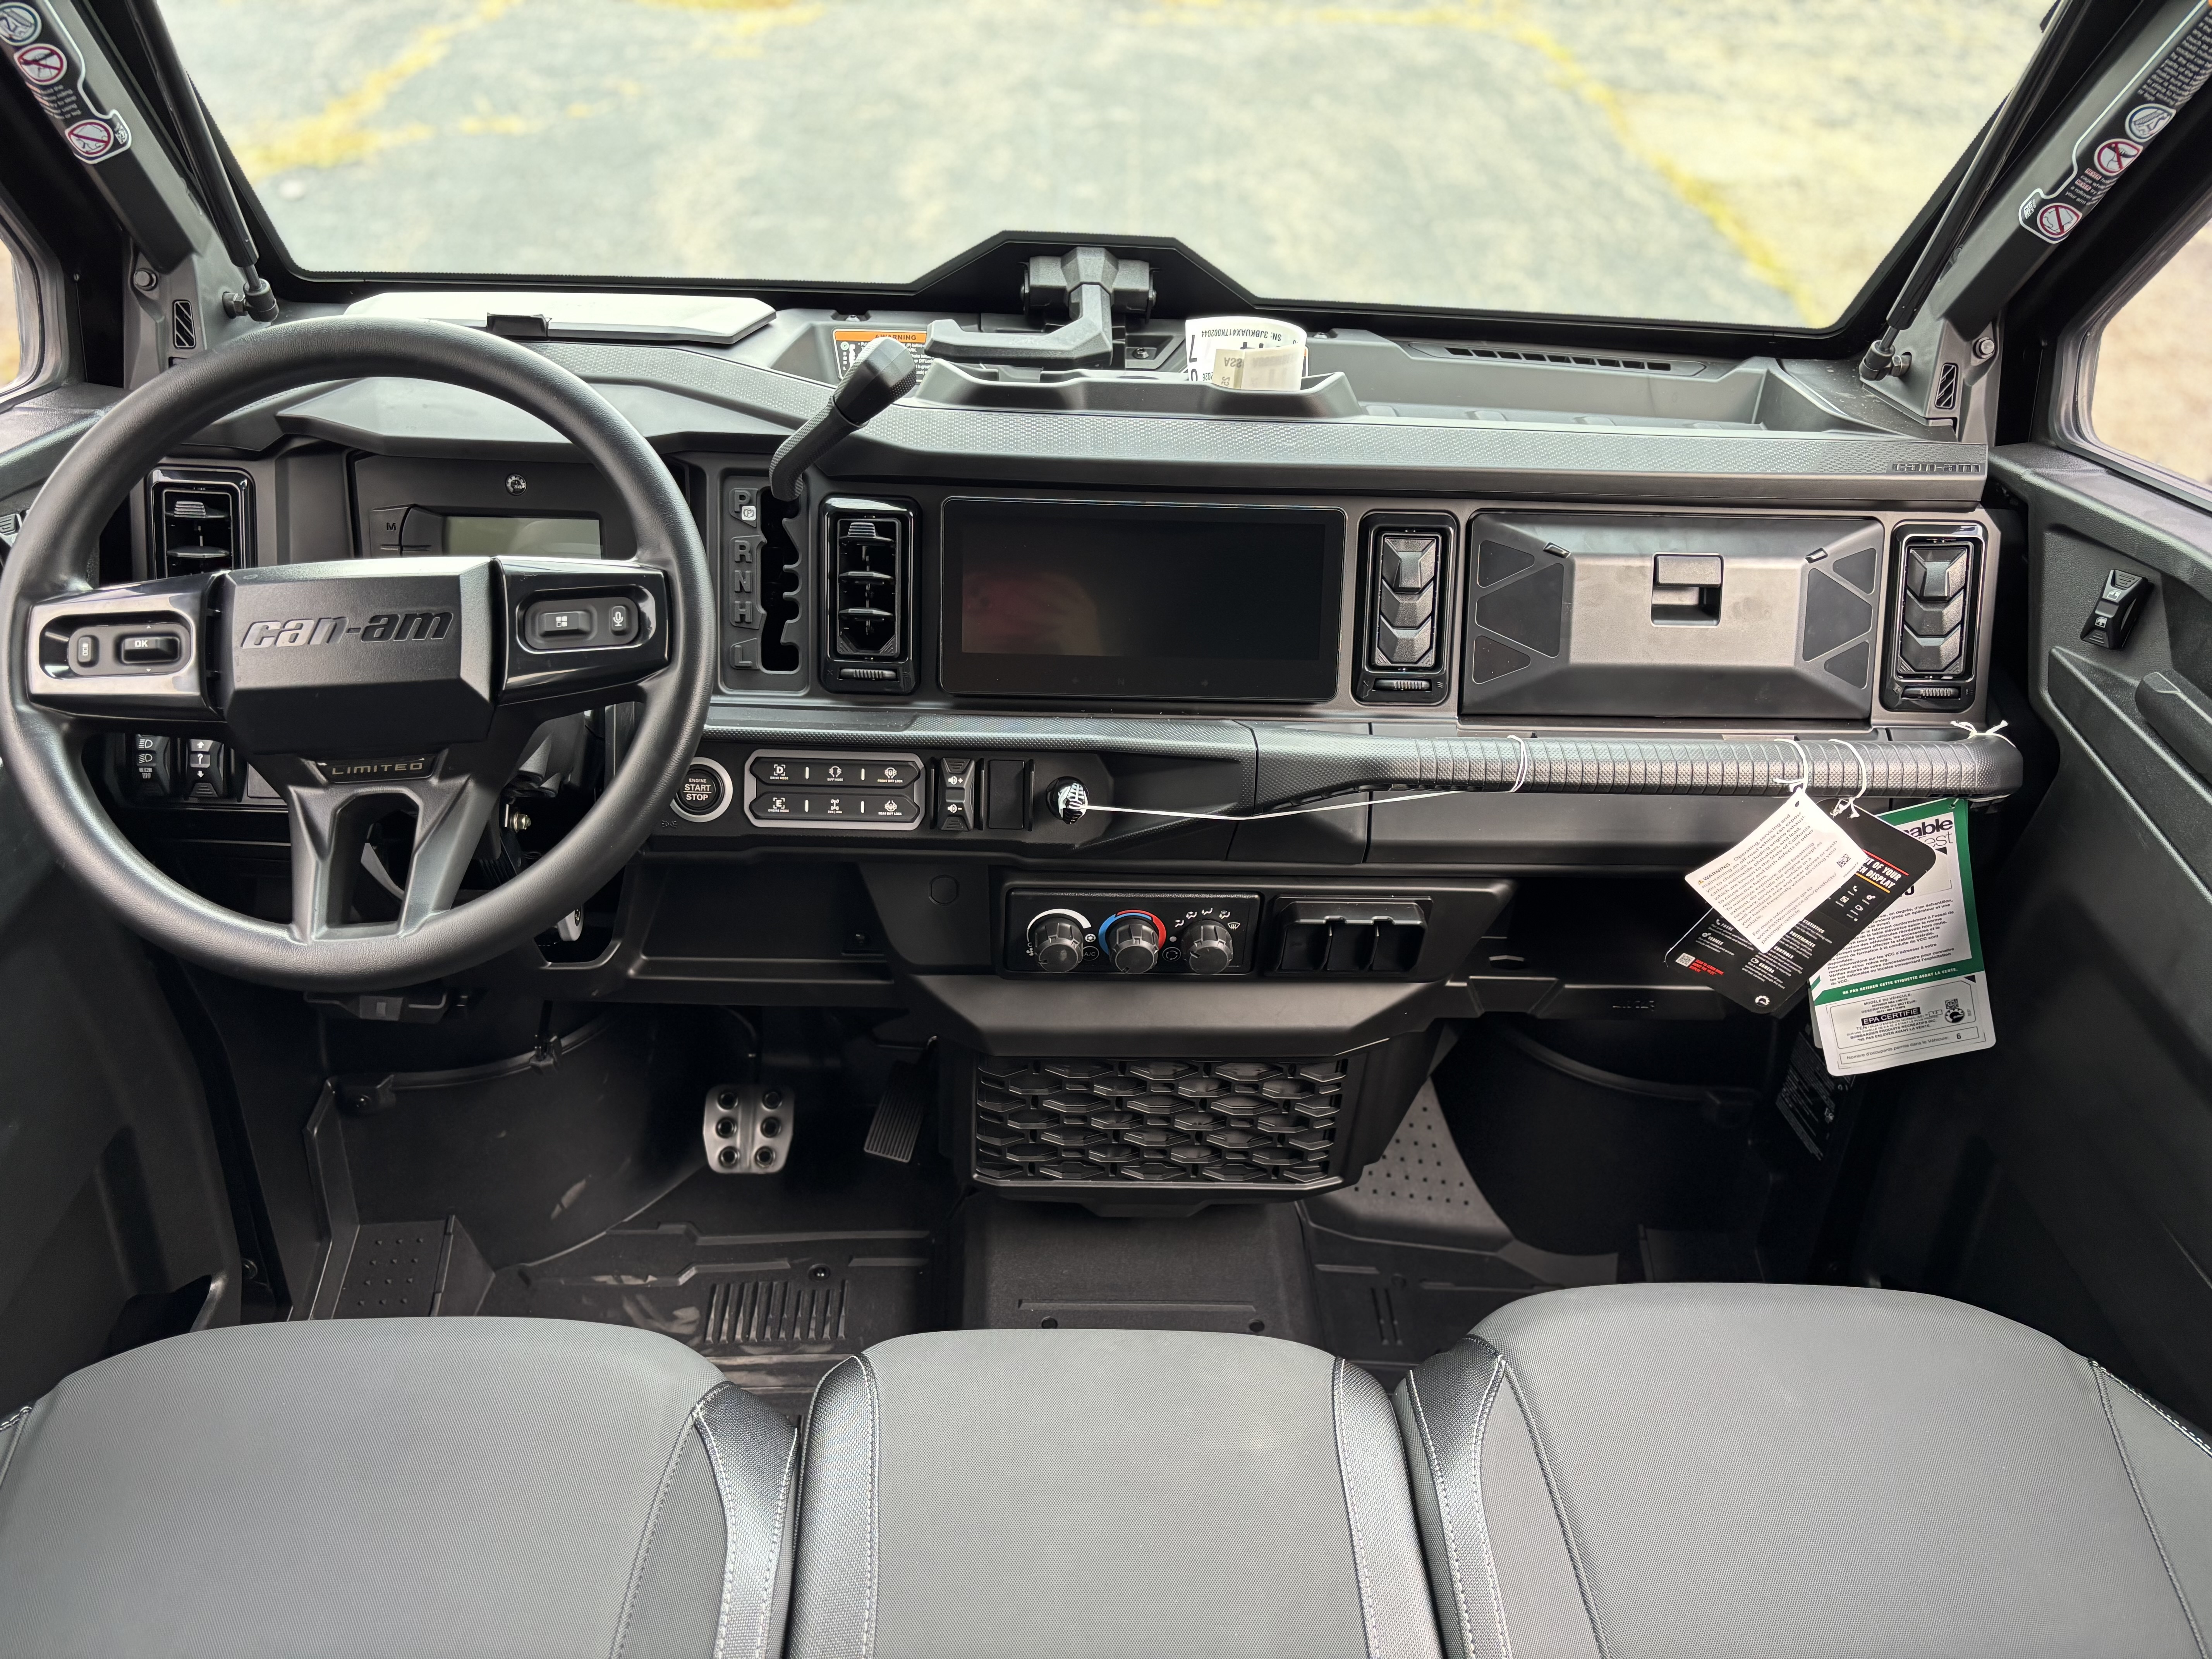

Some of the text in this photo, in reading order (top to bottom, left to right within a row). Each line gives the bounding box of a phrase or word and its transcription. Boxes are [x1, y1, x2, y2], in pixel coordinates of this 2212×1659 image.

[2080, 175, 2092, 184] cage
[2085, 168, 2101, 180] NEVER
[2074, 188, 2092, 199] rollover
[2075, 179, 2092, 191] NEVER
[1271, 332, 1282, 341] SN:
[1892, 463, 1980, 472] can-am
[734, 489, 750, 513] P
[386, 522, 397, 531] M
[734, 541, 752, 563] R
[734, 570, 752, 593] N
[734, 601, 752, 623] H
[242, 611, 454, 649] can-am
[134, 640, 148, 648] OK
[734, 646, 752, 668] L
[331, 763, 423, 775] LIMITED
[684, 784, 711, 792] START
[1759, 823, 1781, 842] servicing
[1781, 814, 1790, 823] and
[1702, 868, 1732, 888] maintaining
[1739, 848, 1759, 864] off-road
[1759, 834, 1776, 848] vehicle
[1785, 811, 1801, 826] expose
[1723, 864, 1747, 882] chemicals
[1747, 846, 1770, 865] including
[1770, 832, 1786, 847] engine
[1714, 889, 1729, 900] which
[1737, 871, 1755, 884] known
[1769, 849, 1782, 859] State
[1788, 825, 1810, 844] California
[1872, 861, 1884, 870] OF
[1882, 866, 1901, 881] YOUR
[1733, 890, 1755, 907] minimize
[1778, 861, 1791, 873] avoid
[1790, 842, 1814, 862] breathing
[1865, 869, 1896, 888] DISPLAY
[1741, 847, 1836, 926] your hands frequently when servicing your
[1760, 918, 1772, 929] more
[1772, 897, 1800, 919] information
[1761, 909, 1800, 944] passenger-vehicle
[1894, 975, 1918, 984] ETIQUETTE
[1861, 1005, 1889, 1013] DESCRIPTION
[1850, 1030, 1878, 1039] BOMBARDIER
[1866, 1047, 1893, 1056] d'occupants
